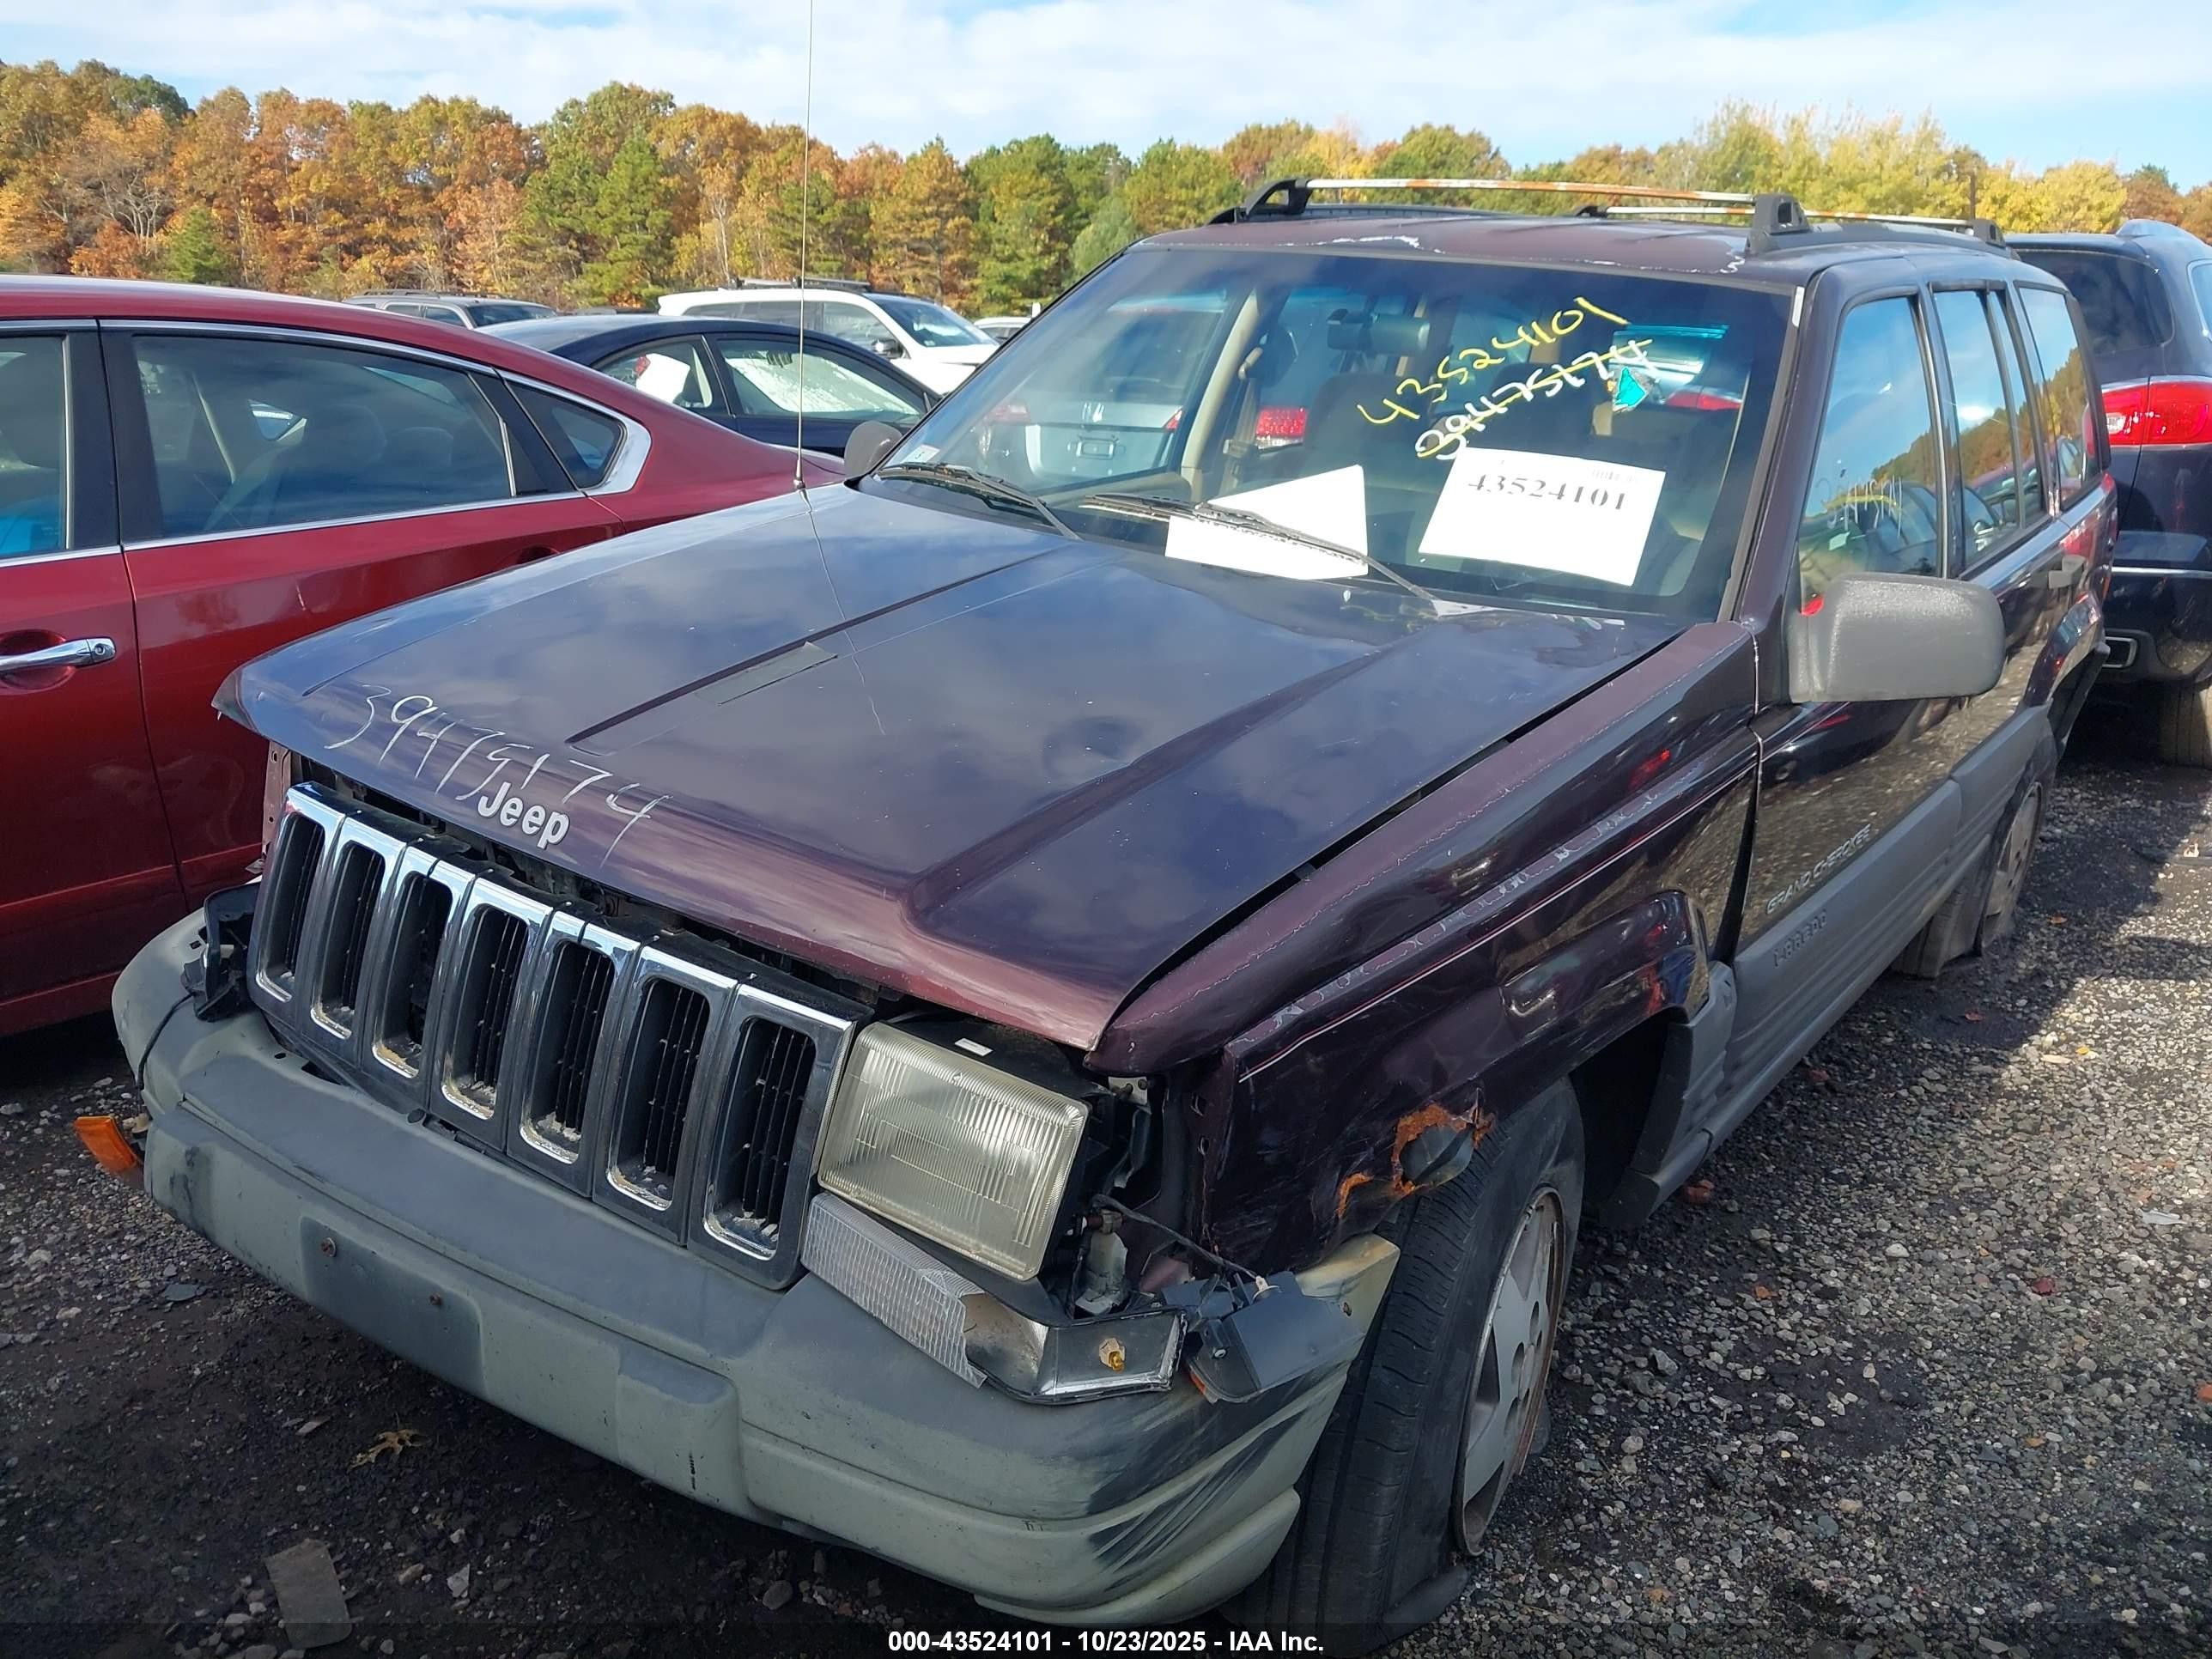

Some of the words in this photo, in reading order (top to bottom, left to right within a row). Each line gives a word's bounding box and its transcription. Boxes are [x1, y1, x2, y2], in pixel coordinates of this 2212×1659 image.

[1358, 296, 1630, 423] 43524101
[1468, 472, 1627, 511] 43524101
[324, 684, 674, 867] 39475174
[477, 781, 571, 849] Jeep
[1766, 871, 1813, 915] GRAND
